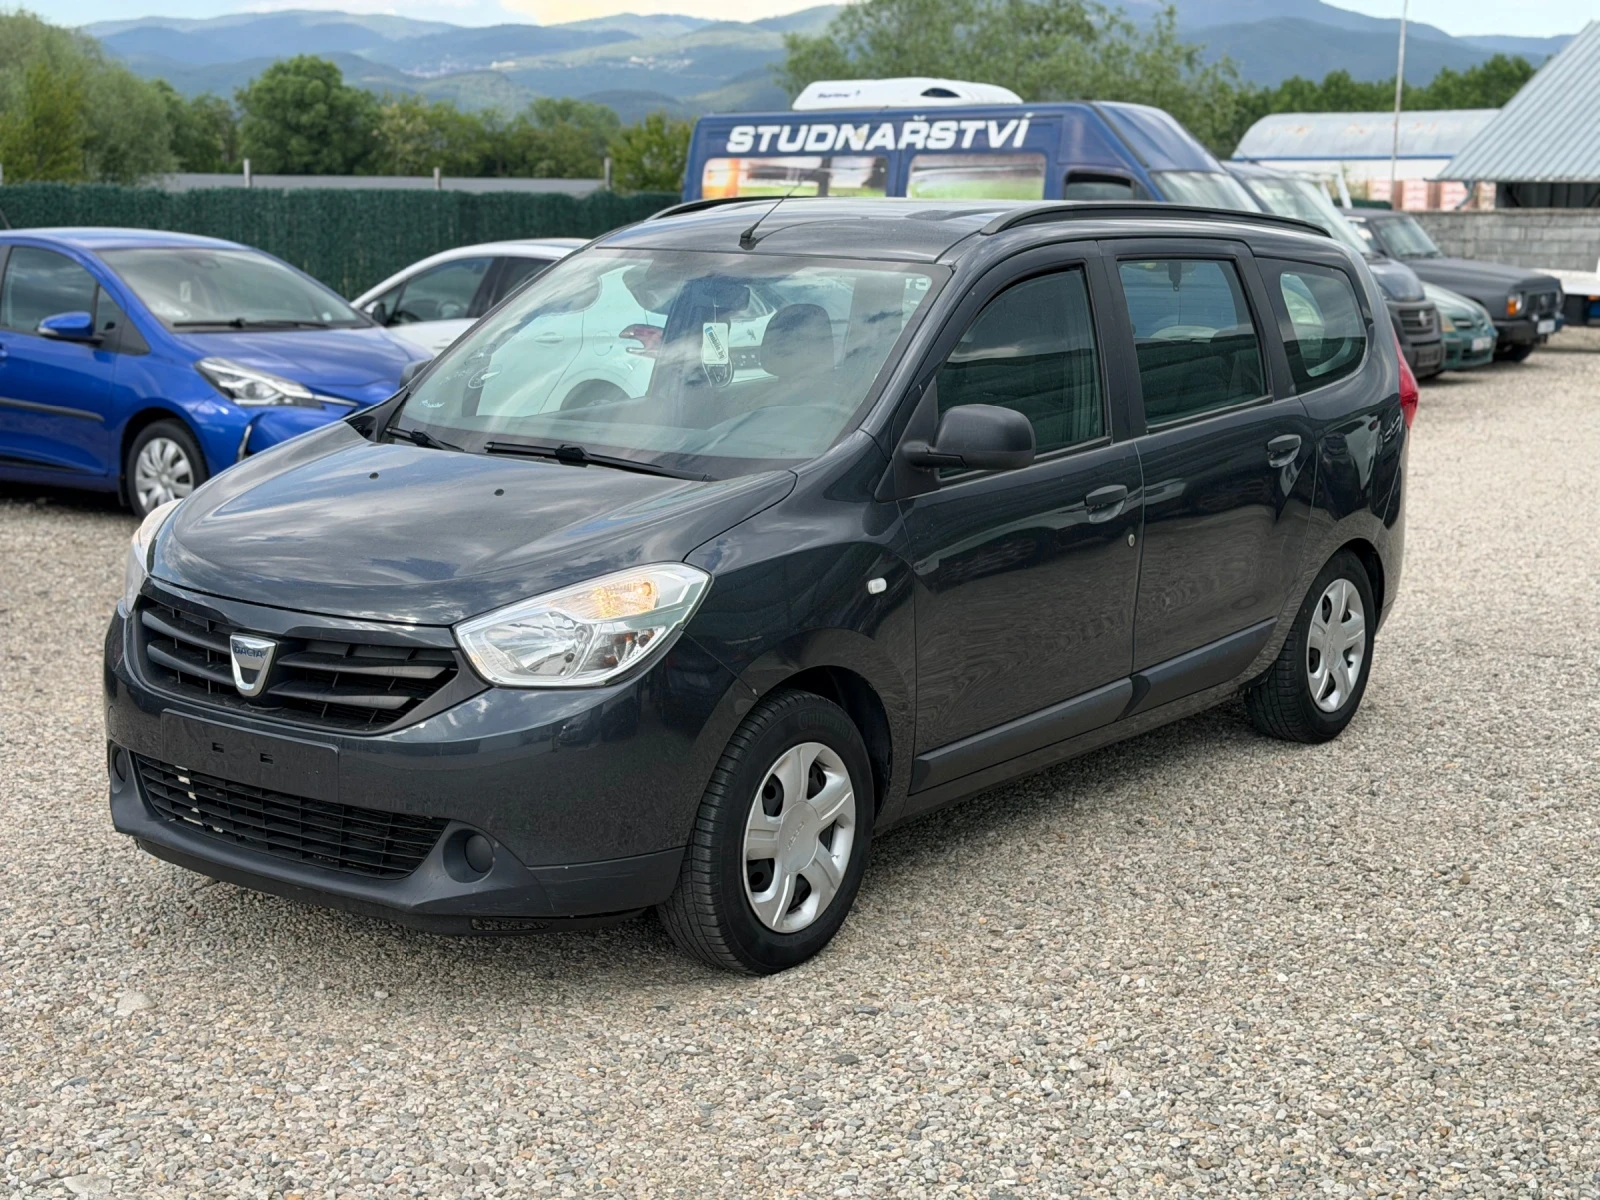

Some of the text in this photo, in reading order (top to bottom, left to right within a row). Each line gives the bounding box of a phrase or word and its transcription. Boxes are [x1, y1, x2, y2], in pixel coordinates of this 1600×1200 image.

[726, 112, 1034, 153] STUDNAŘSTVÍ
[708, 331, 725, 359] mobile.bg
[234, 646, 264, 658] DACIA
